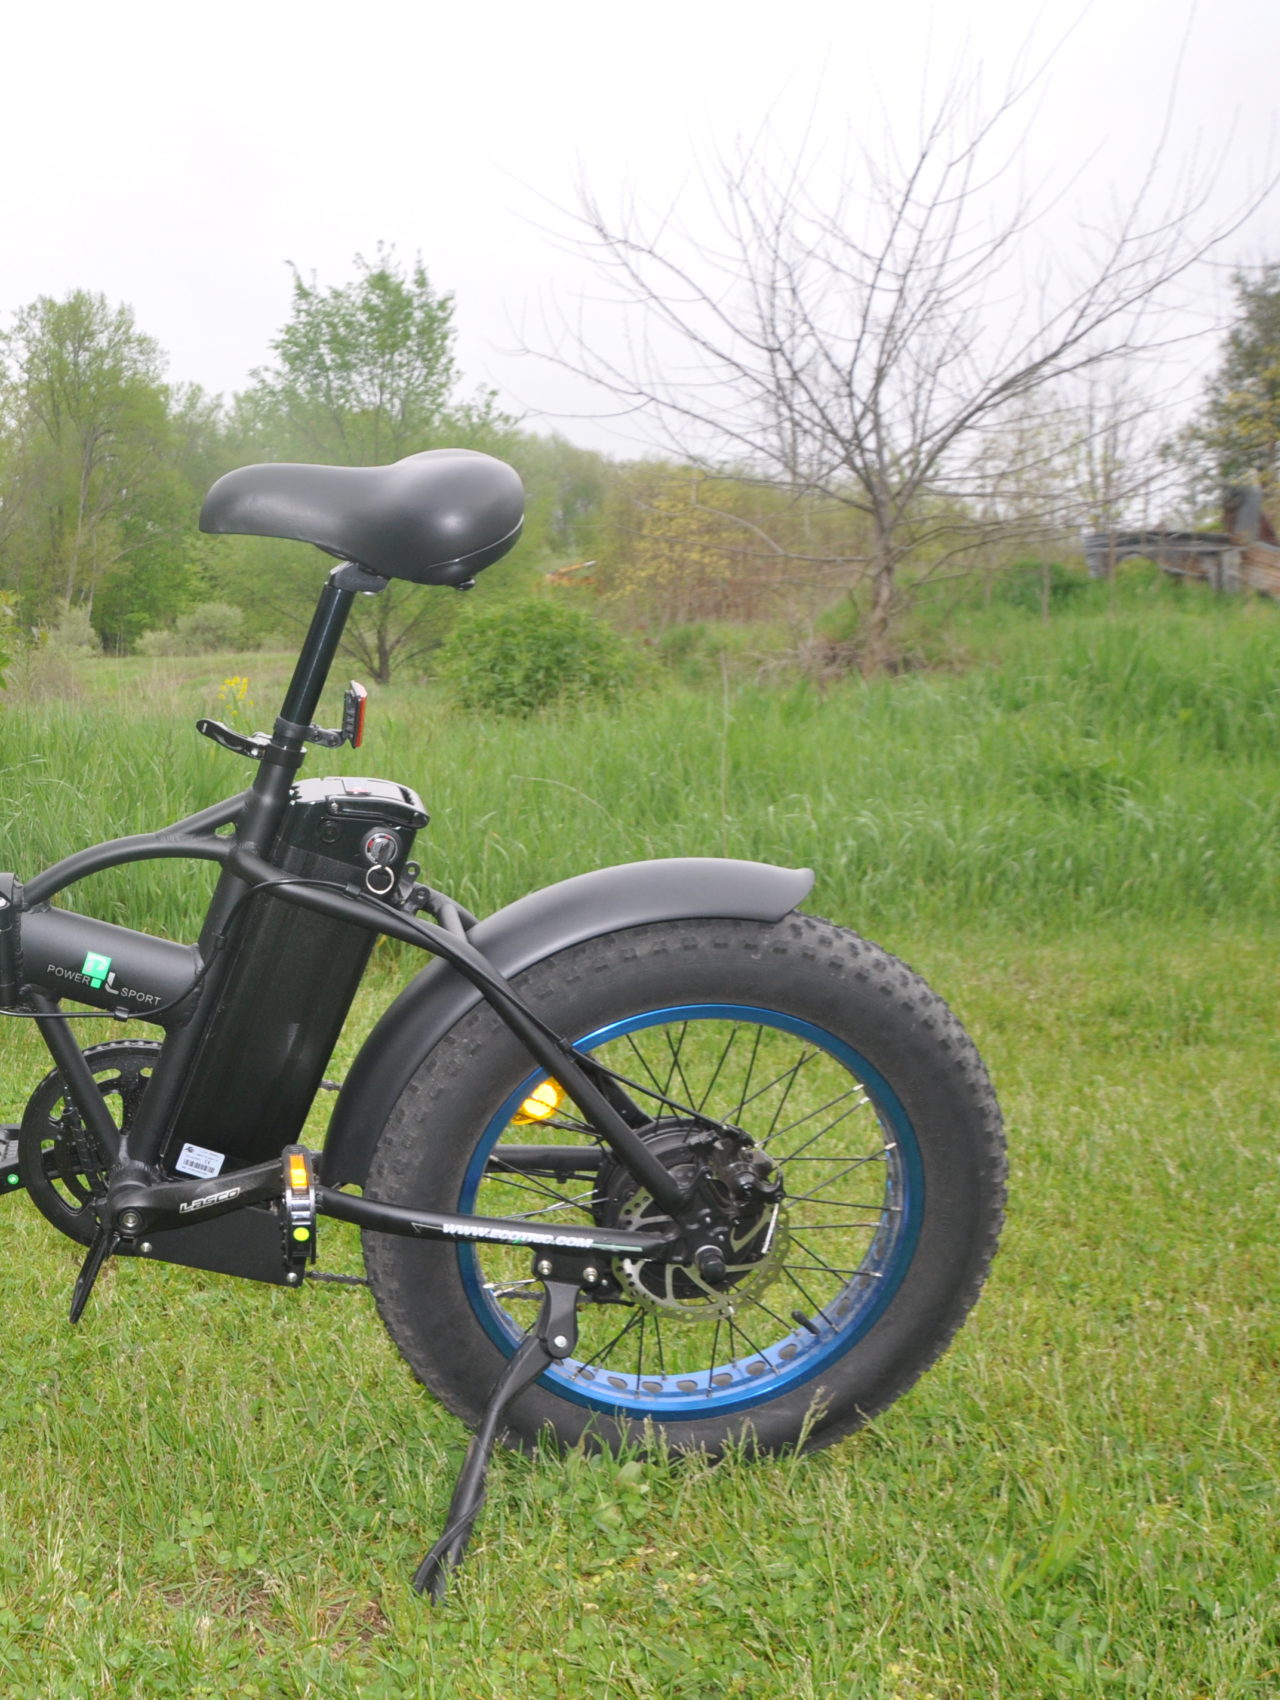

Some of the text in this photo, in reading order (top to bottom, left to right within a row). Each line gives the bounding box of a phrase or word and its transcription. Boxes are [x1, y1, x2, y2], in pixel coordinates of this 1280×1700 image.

[47, 964, 161, 1006] POWER SPORT
[443, 1223, 595, 1248] WWW.ECOTRIC.COM
